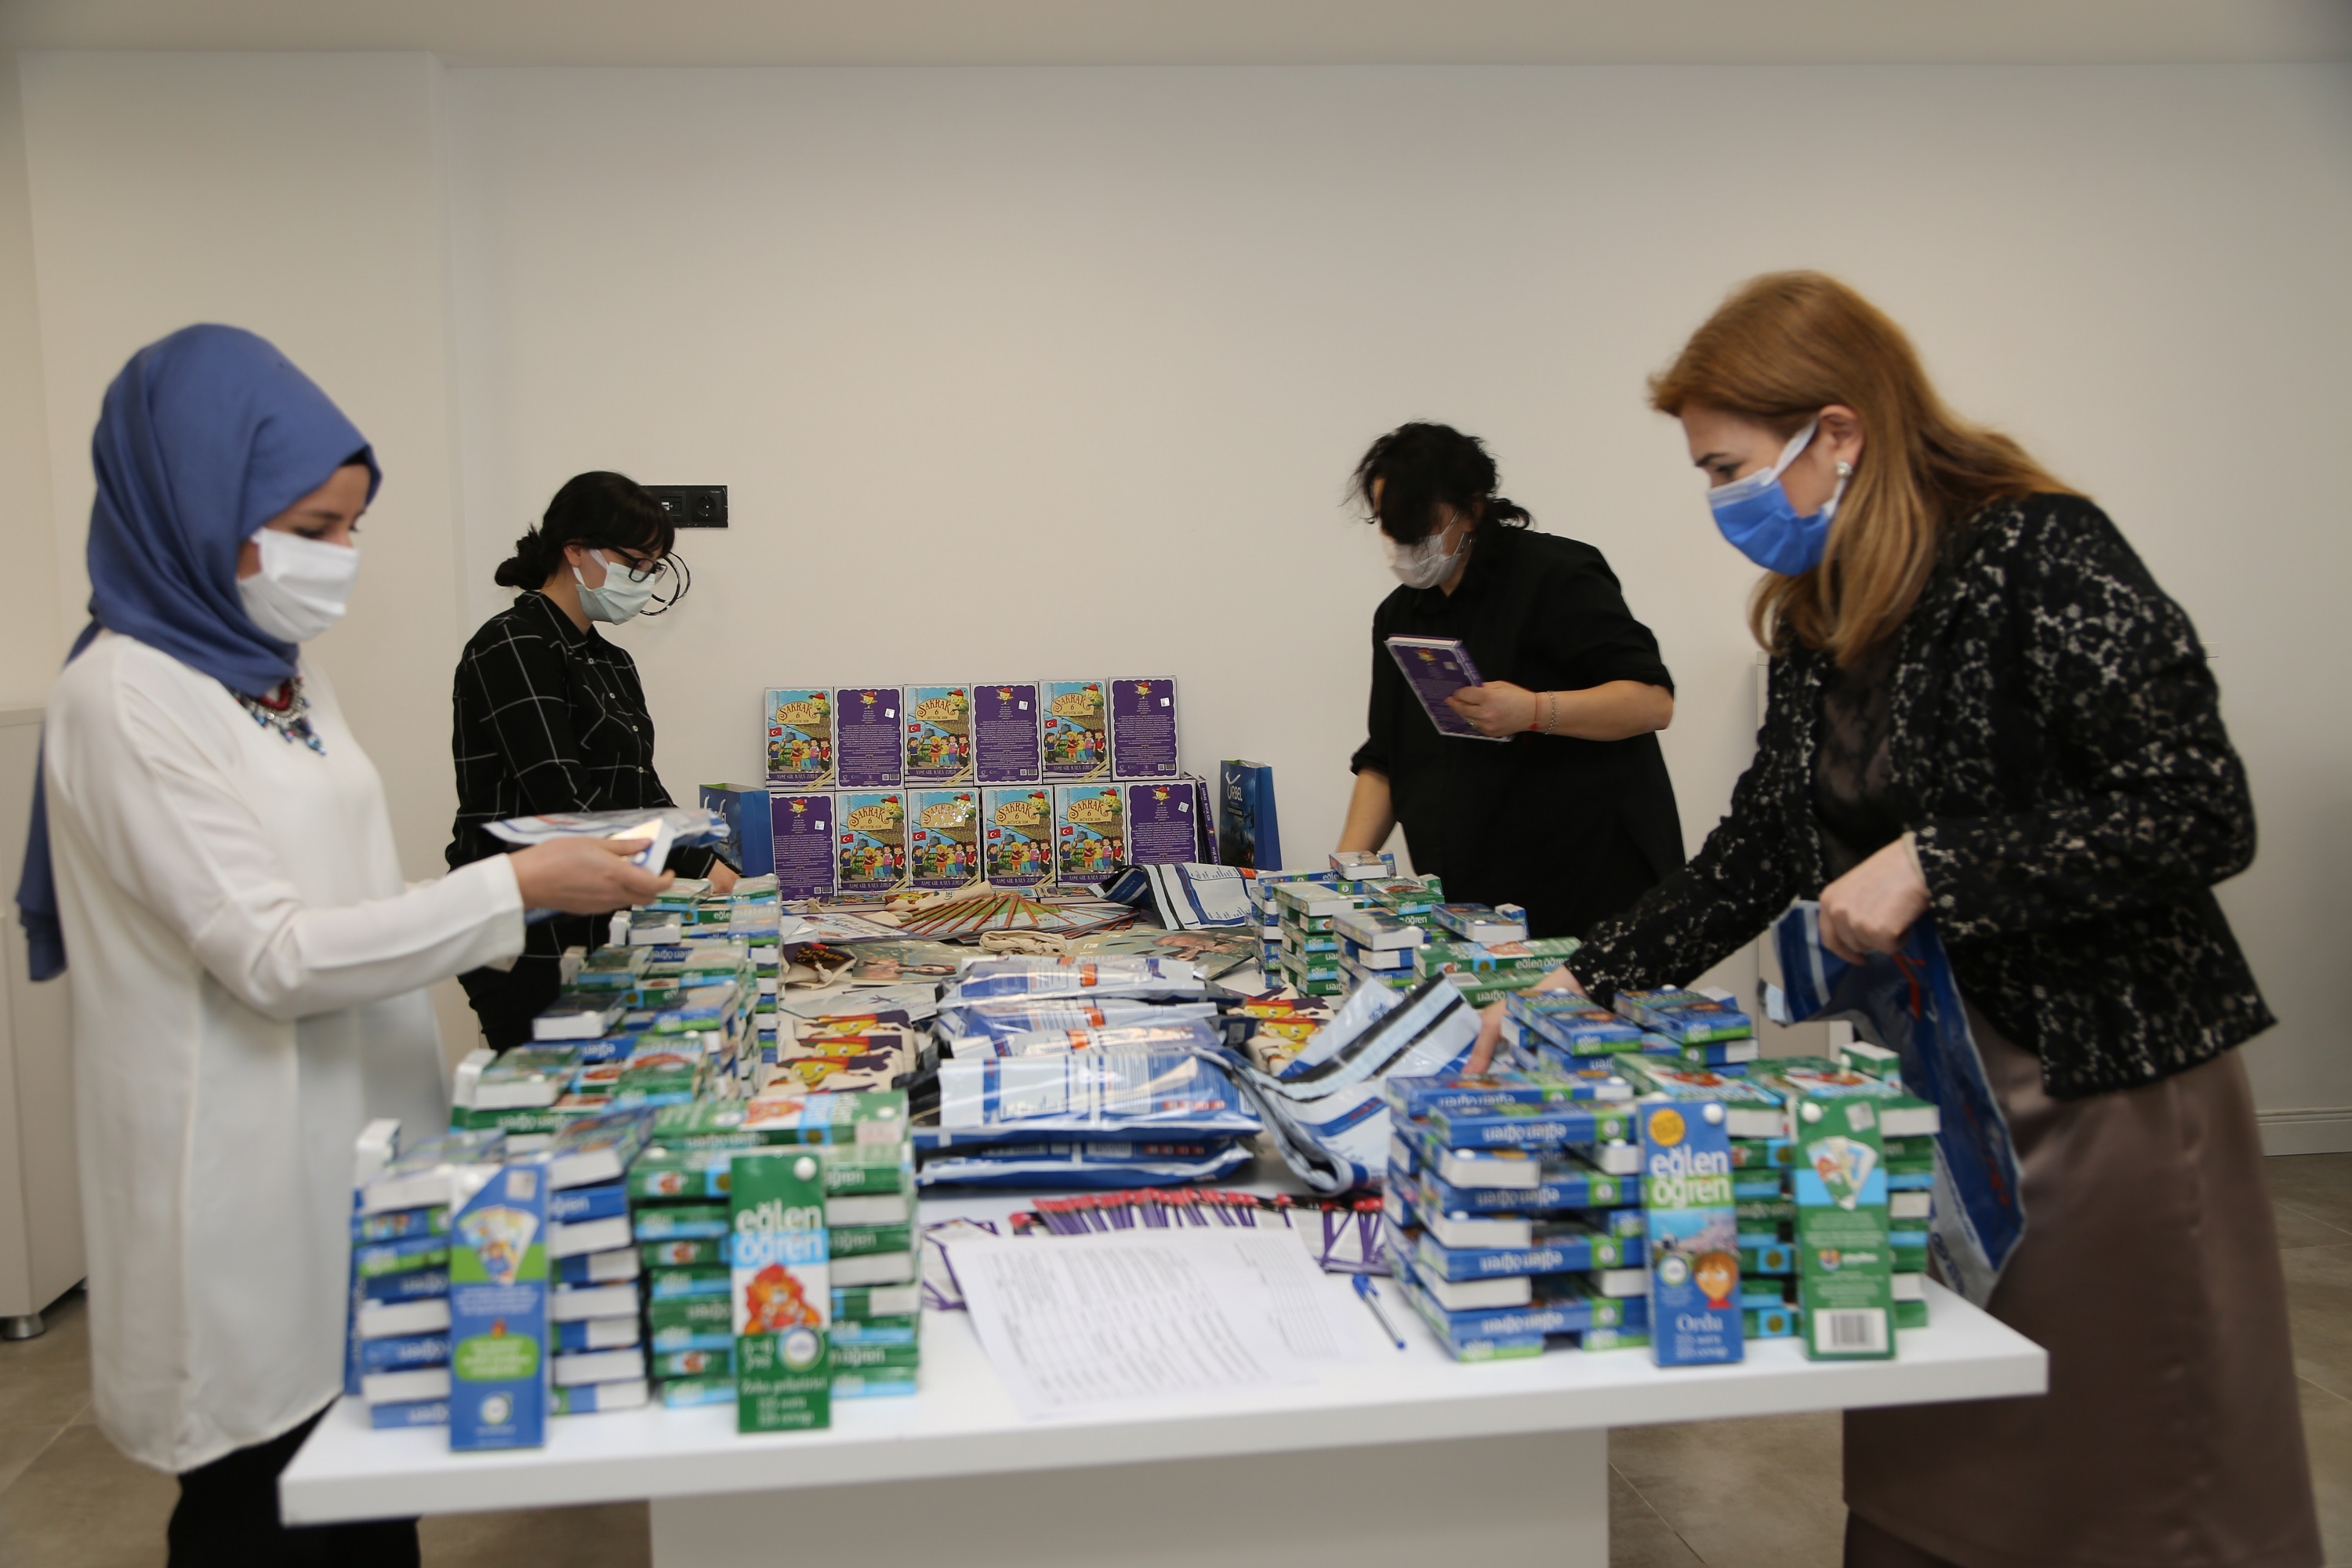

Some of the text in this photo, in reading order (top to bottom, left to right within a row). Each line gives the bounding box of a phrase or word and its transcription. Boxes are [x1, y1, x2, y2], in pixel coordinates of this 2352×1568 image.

[713, 911, 731, 920] eğle
[1405, 915, 1428, 925] öğren
[1515, 956, 1543, 969] eğlen
[1482, 1122, 1567, 1143] eğlen öğren
[1650, 1144, 1730, 1181] eğlen
[1652, 1174, 1732, 1207] öğren
[735, 1198, 823, 1234] eğlen
[735, 1231, 823, 1265] öğren
[1675, 1312, 1723, 1333] Ordu
